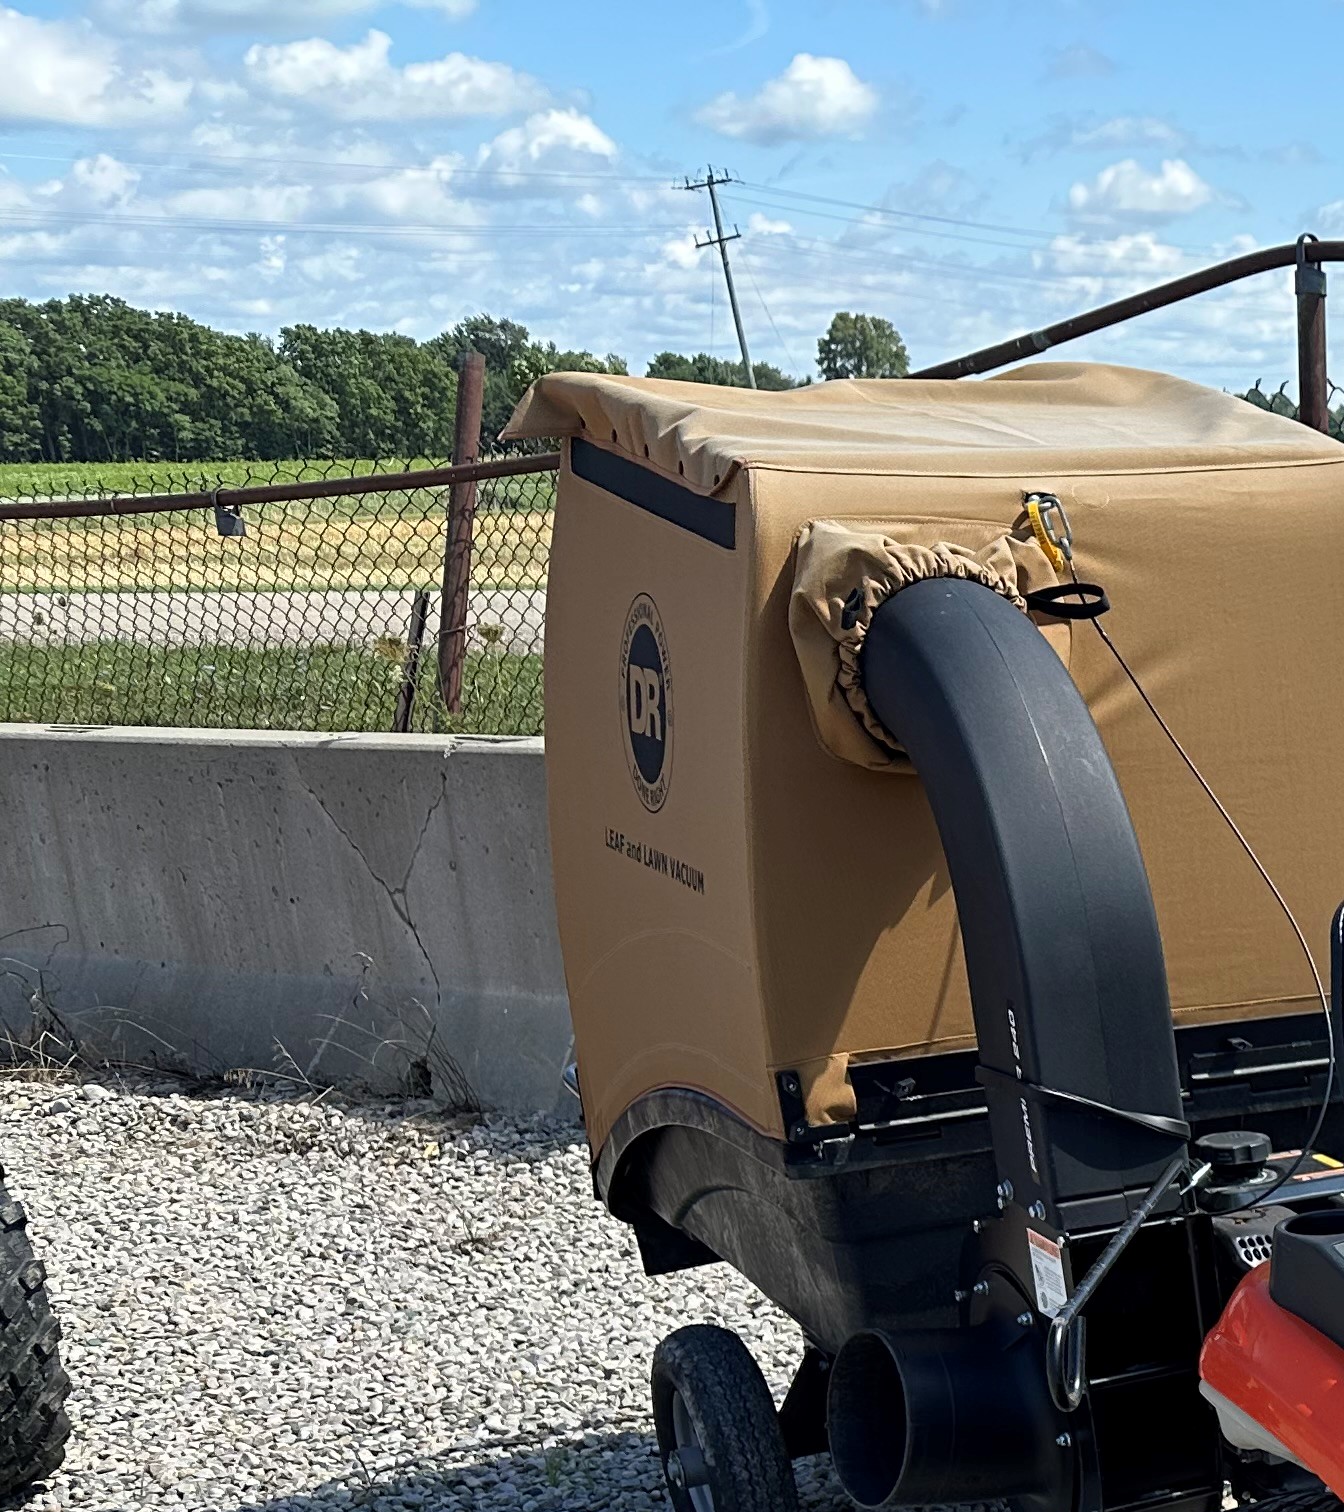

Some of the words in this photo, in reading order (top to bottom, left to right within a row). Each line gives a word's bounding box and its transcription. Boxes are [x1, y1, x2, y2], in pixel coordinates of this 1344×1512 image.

[629, 663, 663, 741] DR
[605, 826, 625, 852] LEAF
[626, 840, 642, 863] and
[643, 850, 668, 876] LAWN
[670, 858, 705, 895] VACUUM
